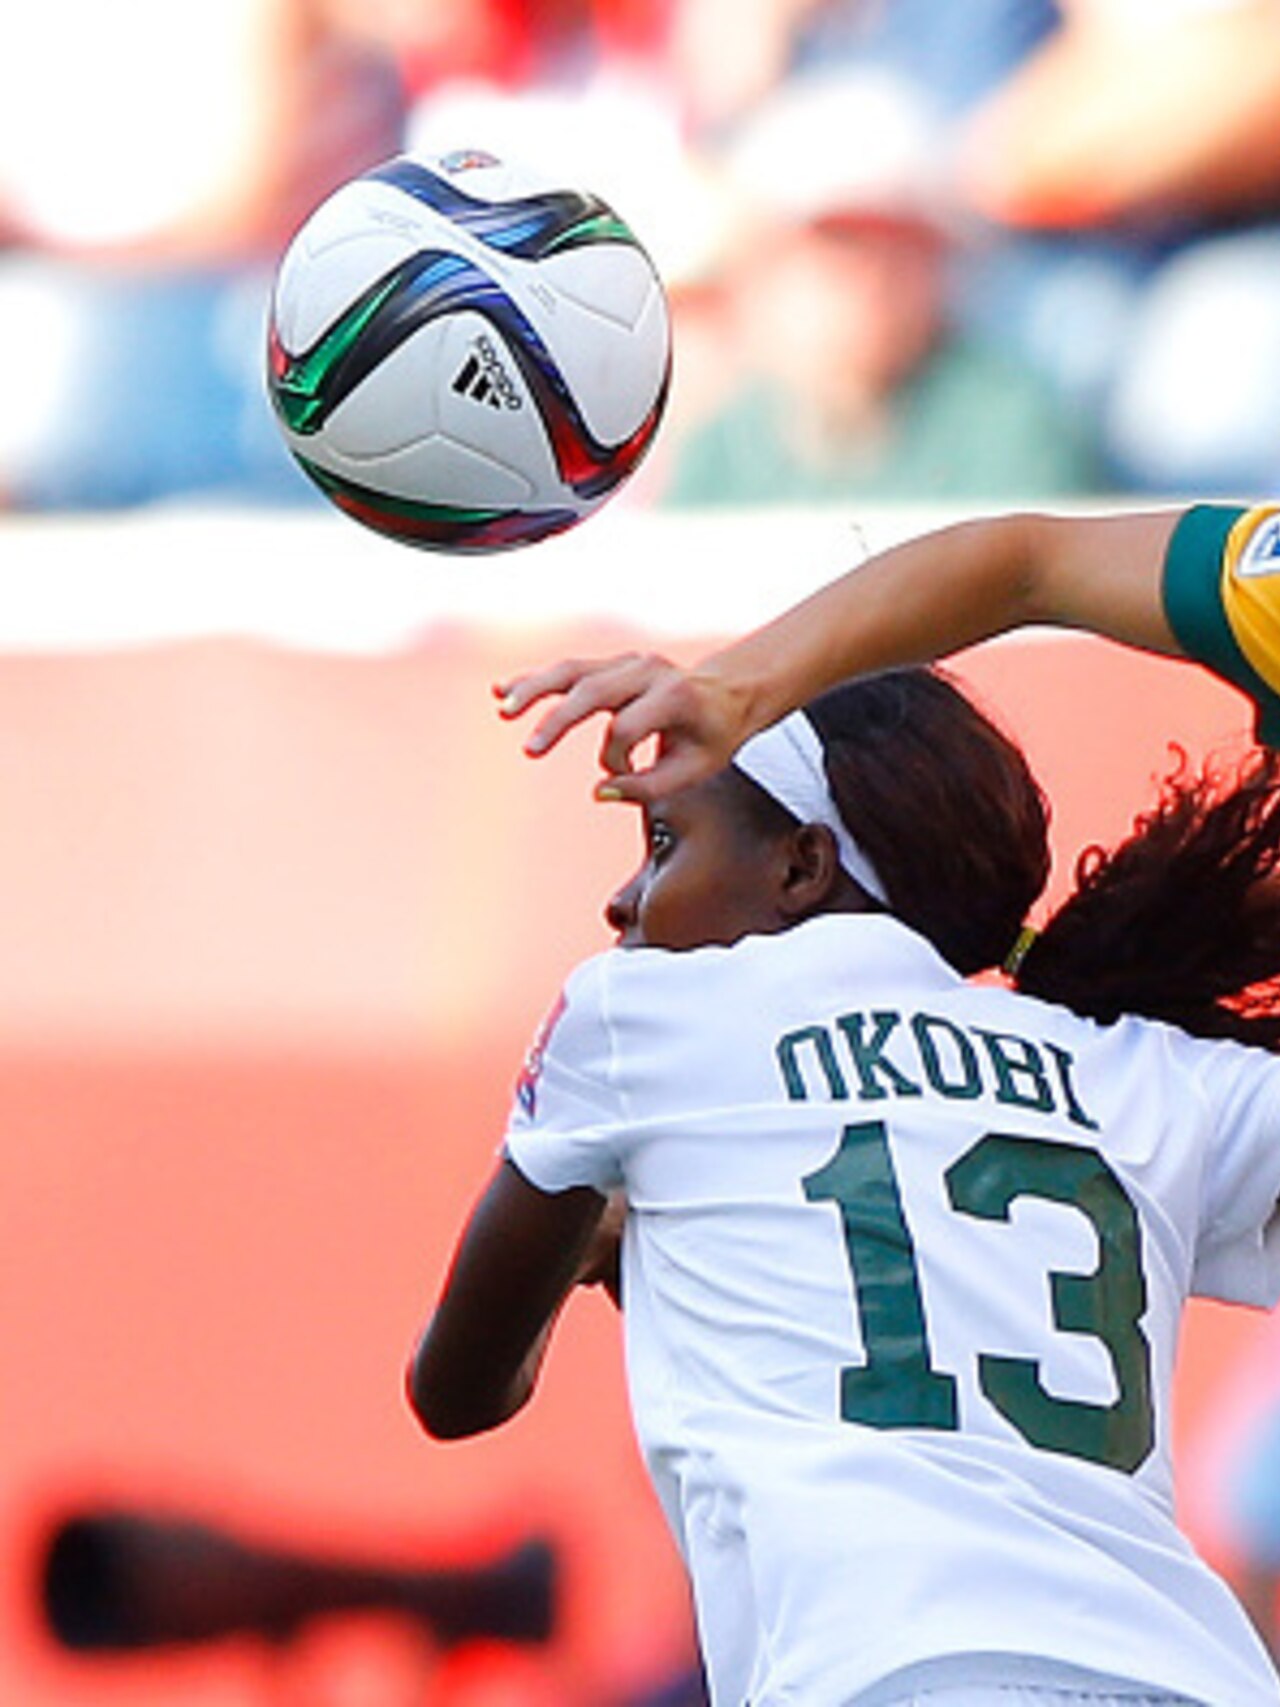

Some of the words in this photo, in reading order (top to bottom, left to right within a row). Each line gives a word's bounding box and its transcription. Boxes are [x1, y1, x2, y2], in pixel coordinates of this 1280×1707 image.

[477, 335, 522, 411] adidas
[775, 1010, 1102, 1133] OKOBI
[800, 1119, 1157, 1477] 13
